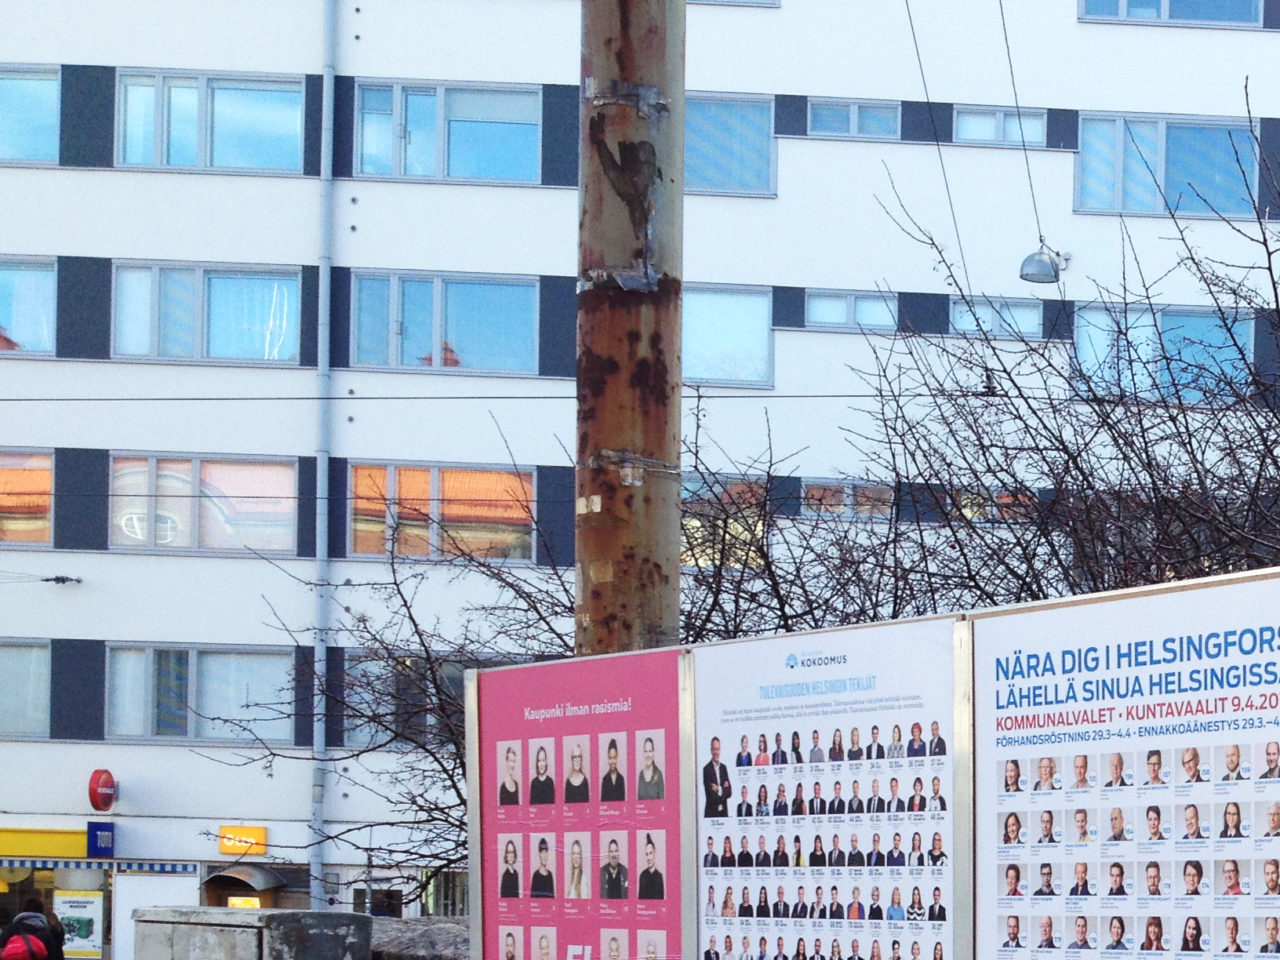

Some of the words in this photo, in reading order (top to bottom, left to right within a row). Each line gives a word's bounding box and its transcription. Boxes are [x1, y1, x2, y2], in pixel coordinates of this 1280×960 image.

[801, 655, 848, 667] KOKOOMUS
[995, 648, 1056, 682] NÄRA
[1061, 646, 1100, 674] DIG
[1105, 646, 1110, 670] I
[995, 676, 1077, 710] LÄHELLÄ
[1082, 675, 1144, 703] SINUA
[524, 703, 564, 722] Kaupunki
[565, 702, 589, 717] ilman
[592, 697, 632, 713] rasismia!
[996, 707, 1116, 731] KOMMUNALVALET
[1126, 698, 1228, 721] KUNTAVAALIT
[996, 730, 1091, 748] FÖRHANDSRÖSTNING
[1138, 719, 1240, 738] ENNAKKOÄÄNESTYS
